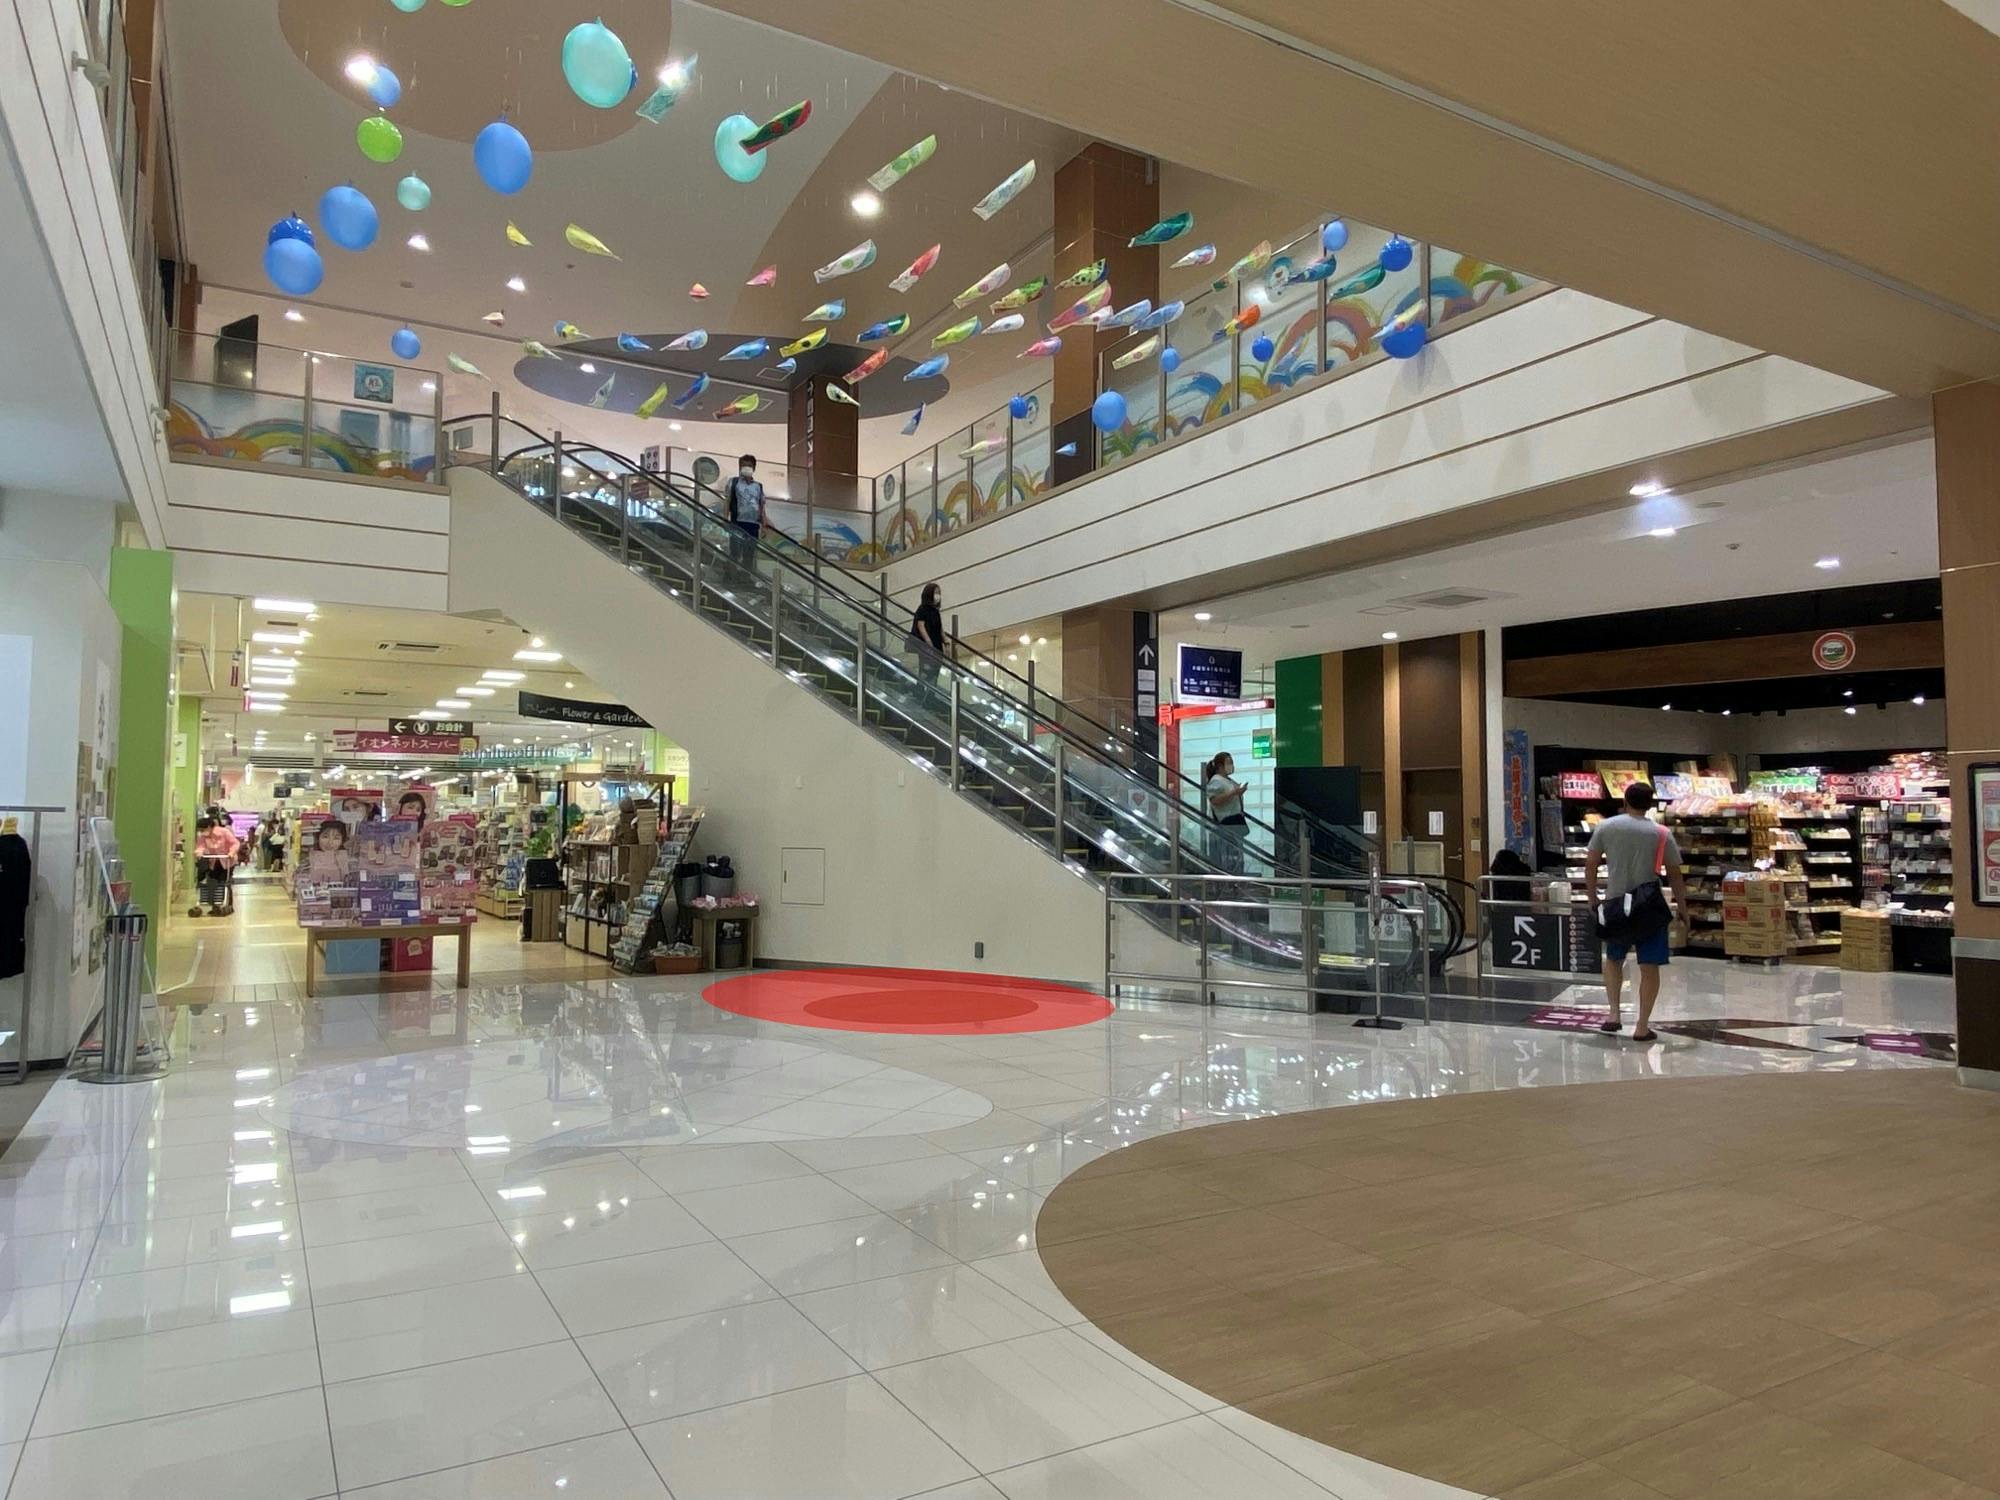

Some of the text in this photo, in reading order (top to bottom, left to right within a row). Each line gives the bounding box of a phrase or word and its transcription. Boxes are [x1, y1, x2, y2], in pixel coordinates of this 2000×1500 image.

[562, 707, 592, 720] Flower
[602, 711, 643, 724] Garden
[435, 722, 464, 733] お会計
[359, 736, 458, 750] イオンネットスーパー
[1511, 940, 1542, 965] 2F
